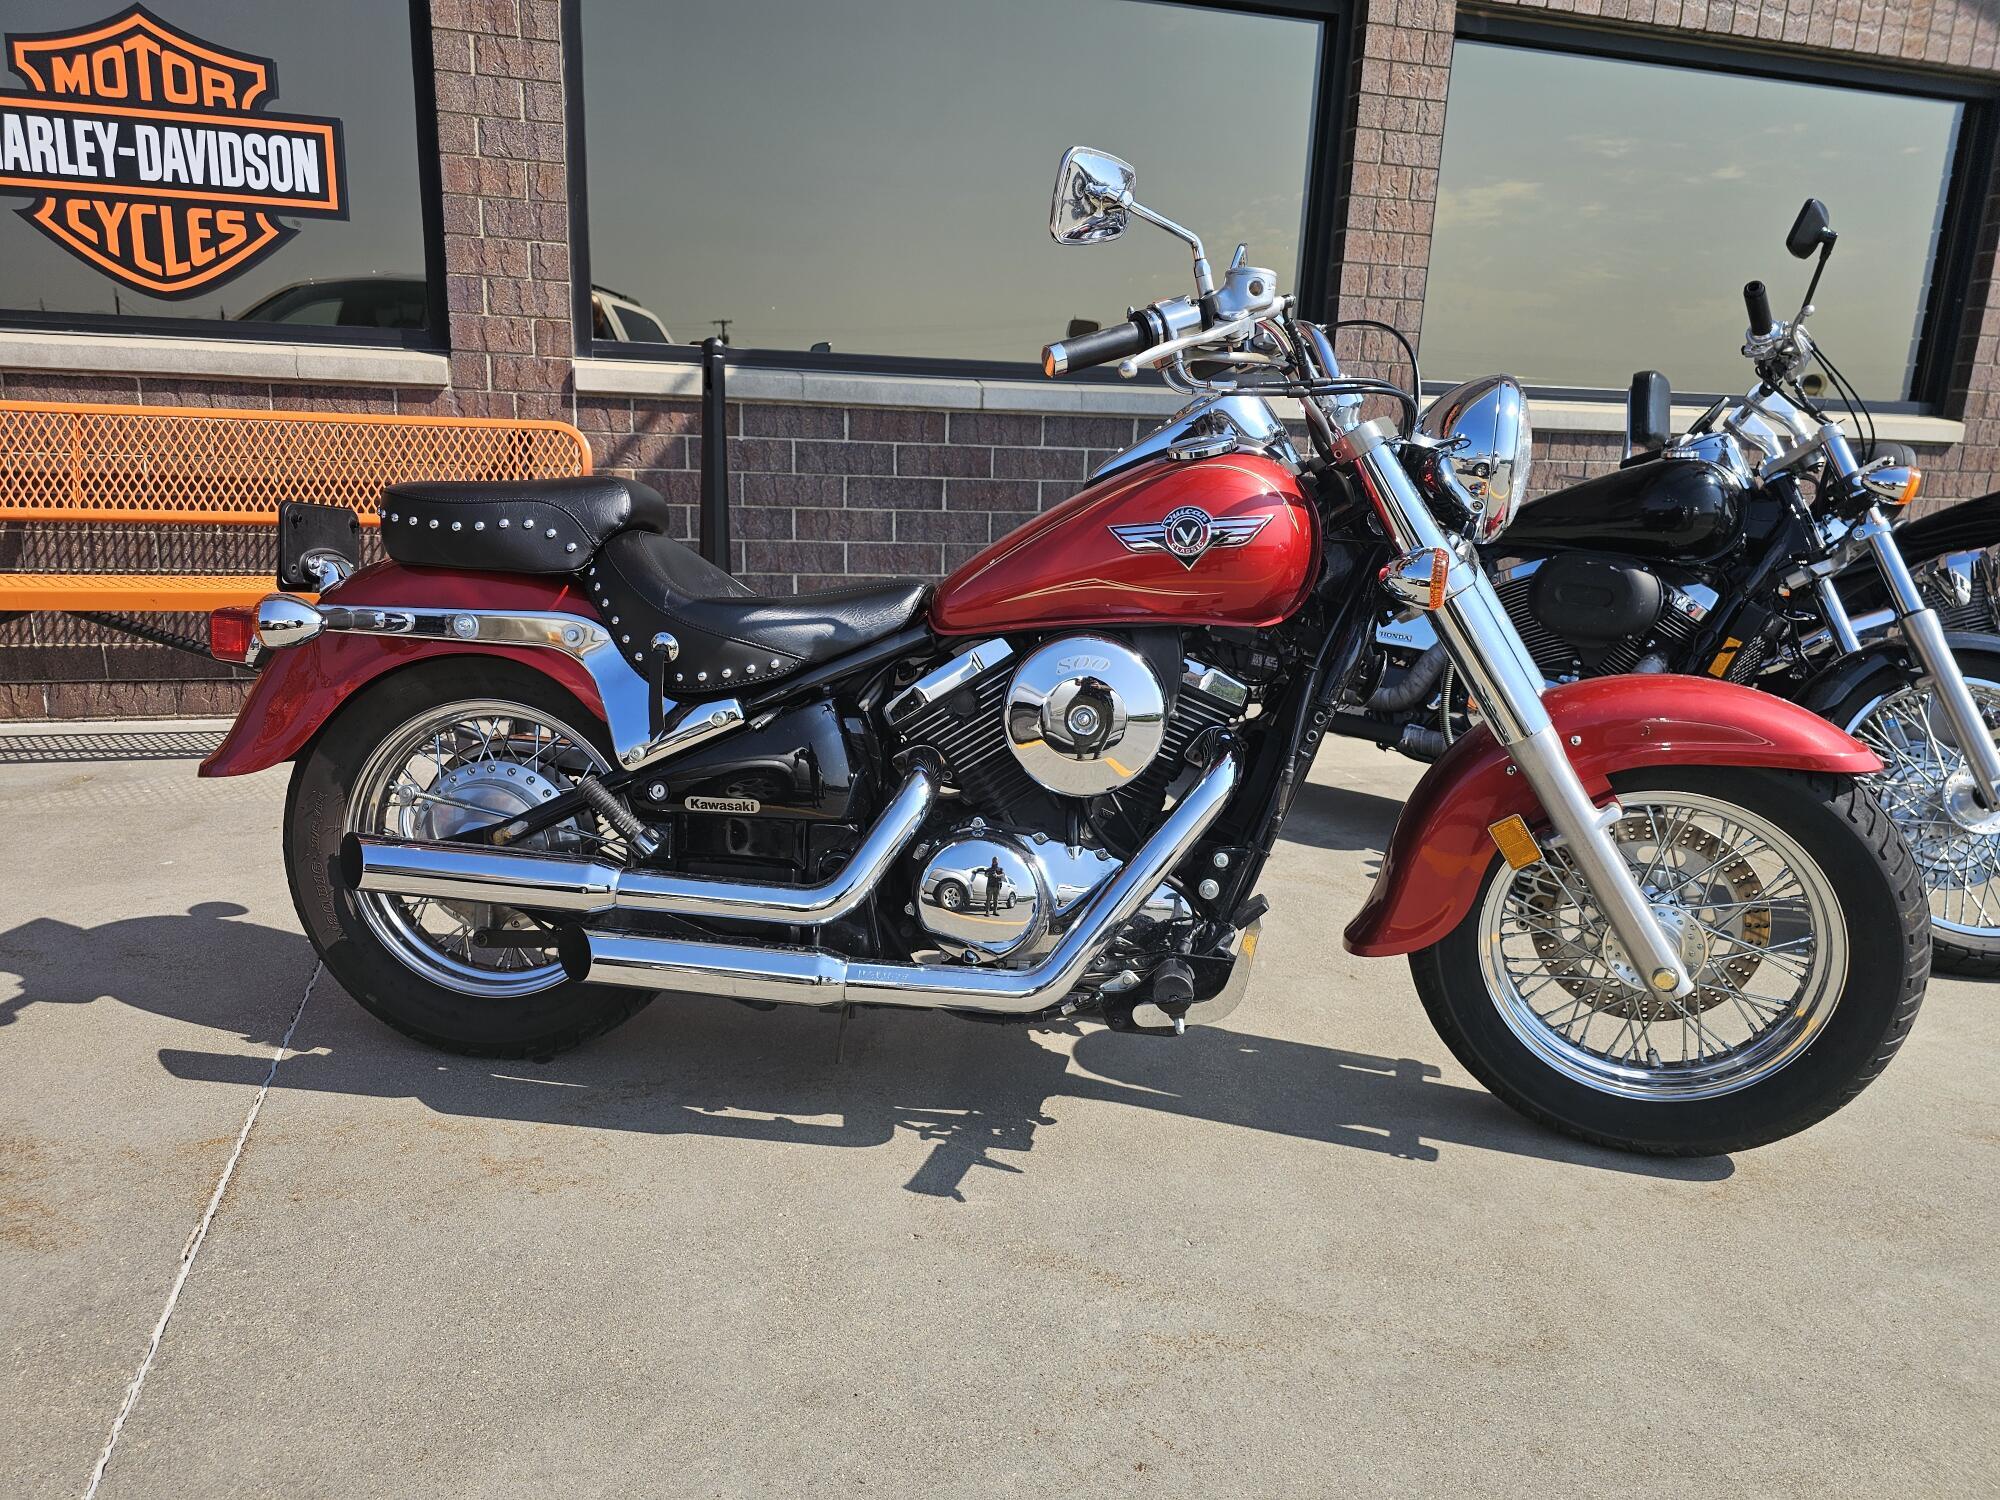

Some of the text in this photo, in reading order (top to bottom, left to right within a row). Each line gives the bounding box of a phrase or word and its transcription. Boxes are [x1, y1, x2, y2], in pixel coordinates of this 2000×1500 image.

[51, 34, 237, 109] MOTOR
[0, 113, 320, 194] ARLEY-DAVIDSON
[65, 198, 248, 276] CYCLES
[1164, 508, 1209, 524] Vulcan
[1175, 525, 1199, 546] V
[1171, 541, 1204, 554] CLASSIC
[1380, 631, 1412, 642] HONDA
[690, 798, 755, 812] Kawasaki
